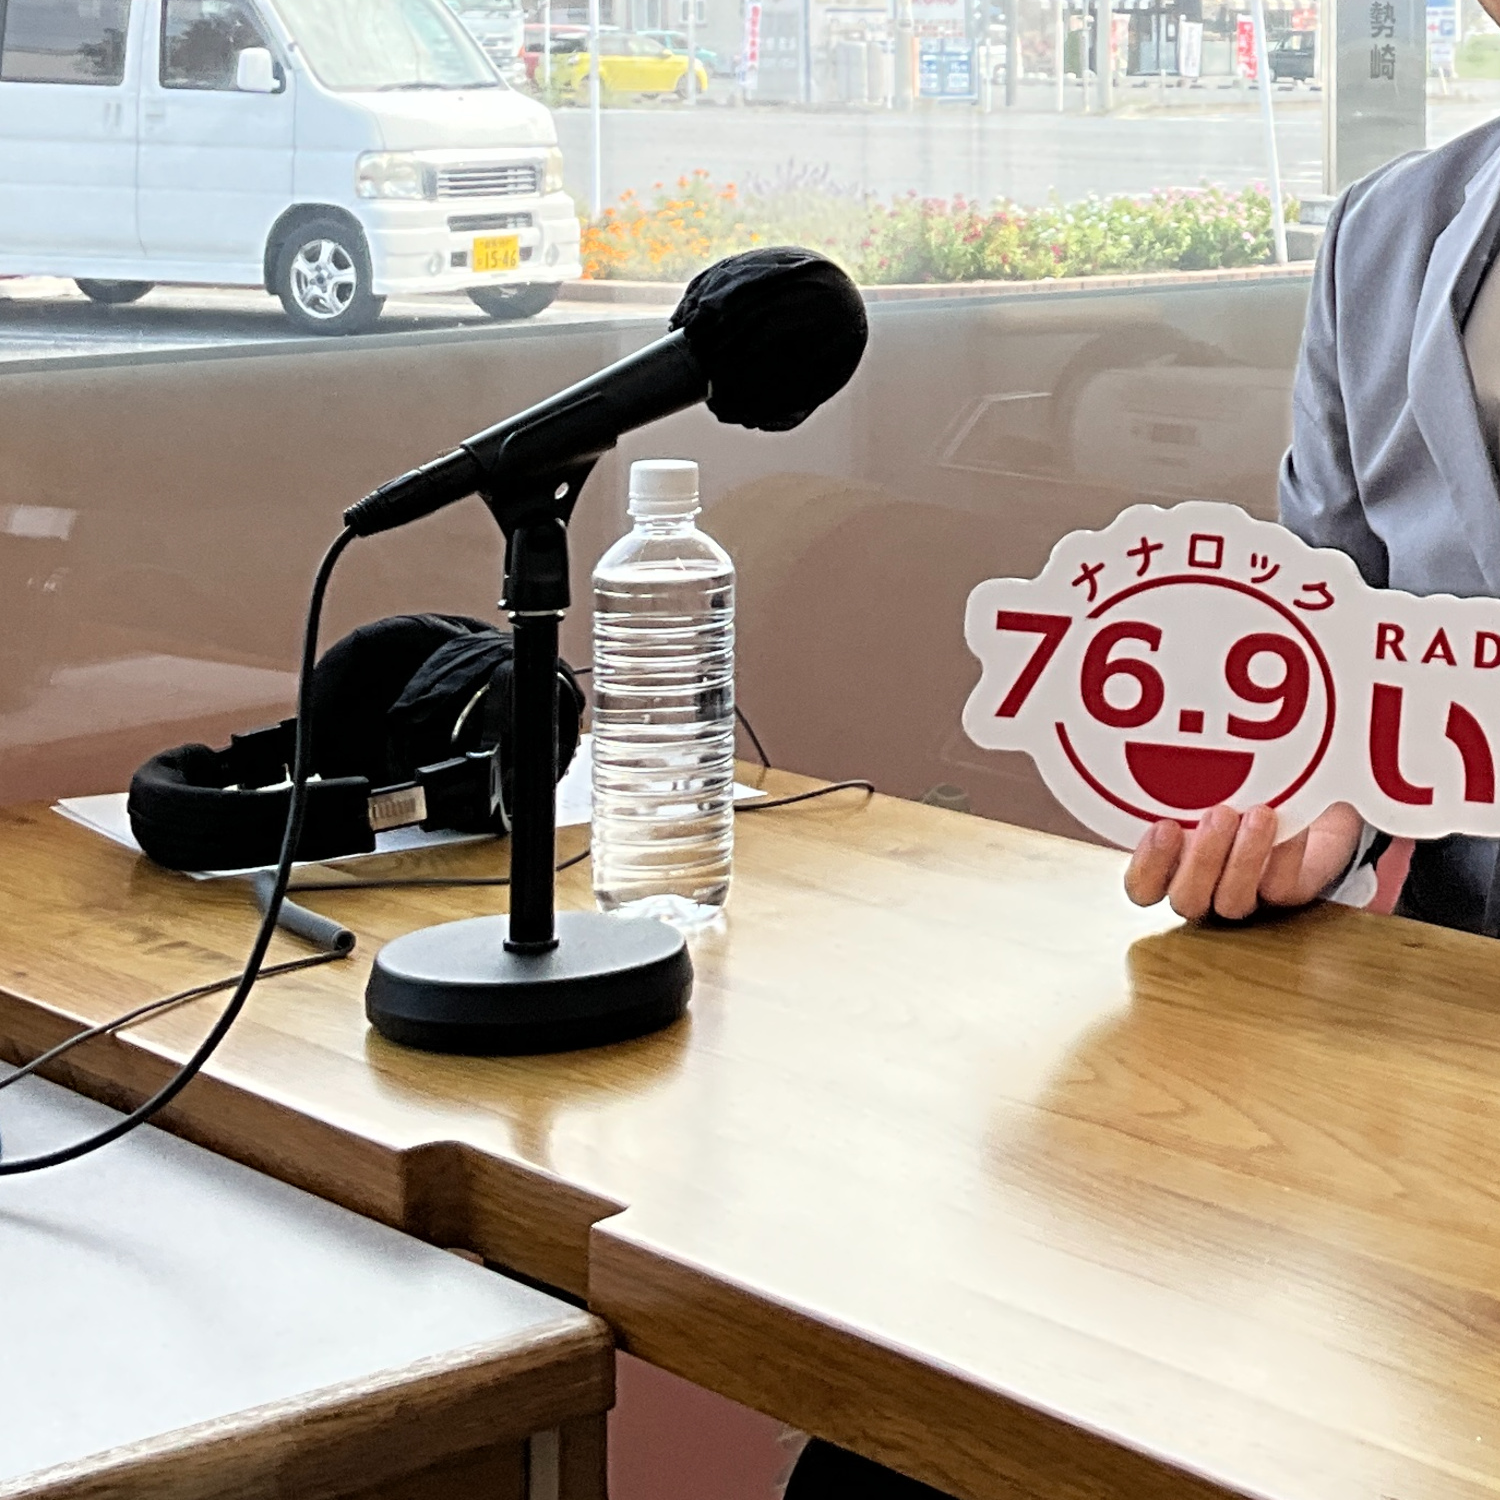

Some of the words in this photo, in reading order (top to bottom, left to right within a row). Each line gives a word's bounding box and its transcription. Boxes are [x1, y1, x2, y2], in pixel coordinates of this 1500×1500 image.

[1071, 533, 1335, 611] ナナロック
[995, 609, 1311, 741] 76.9
